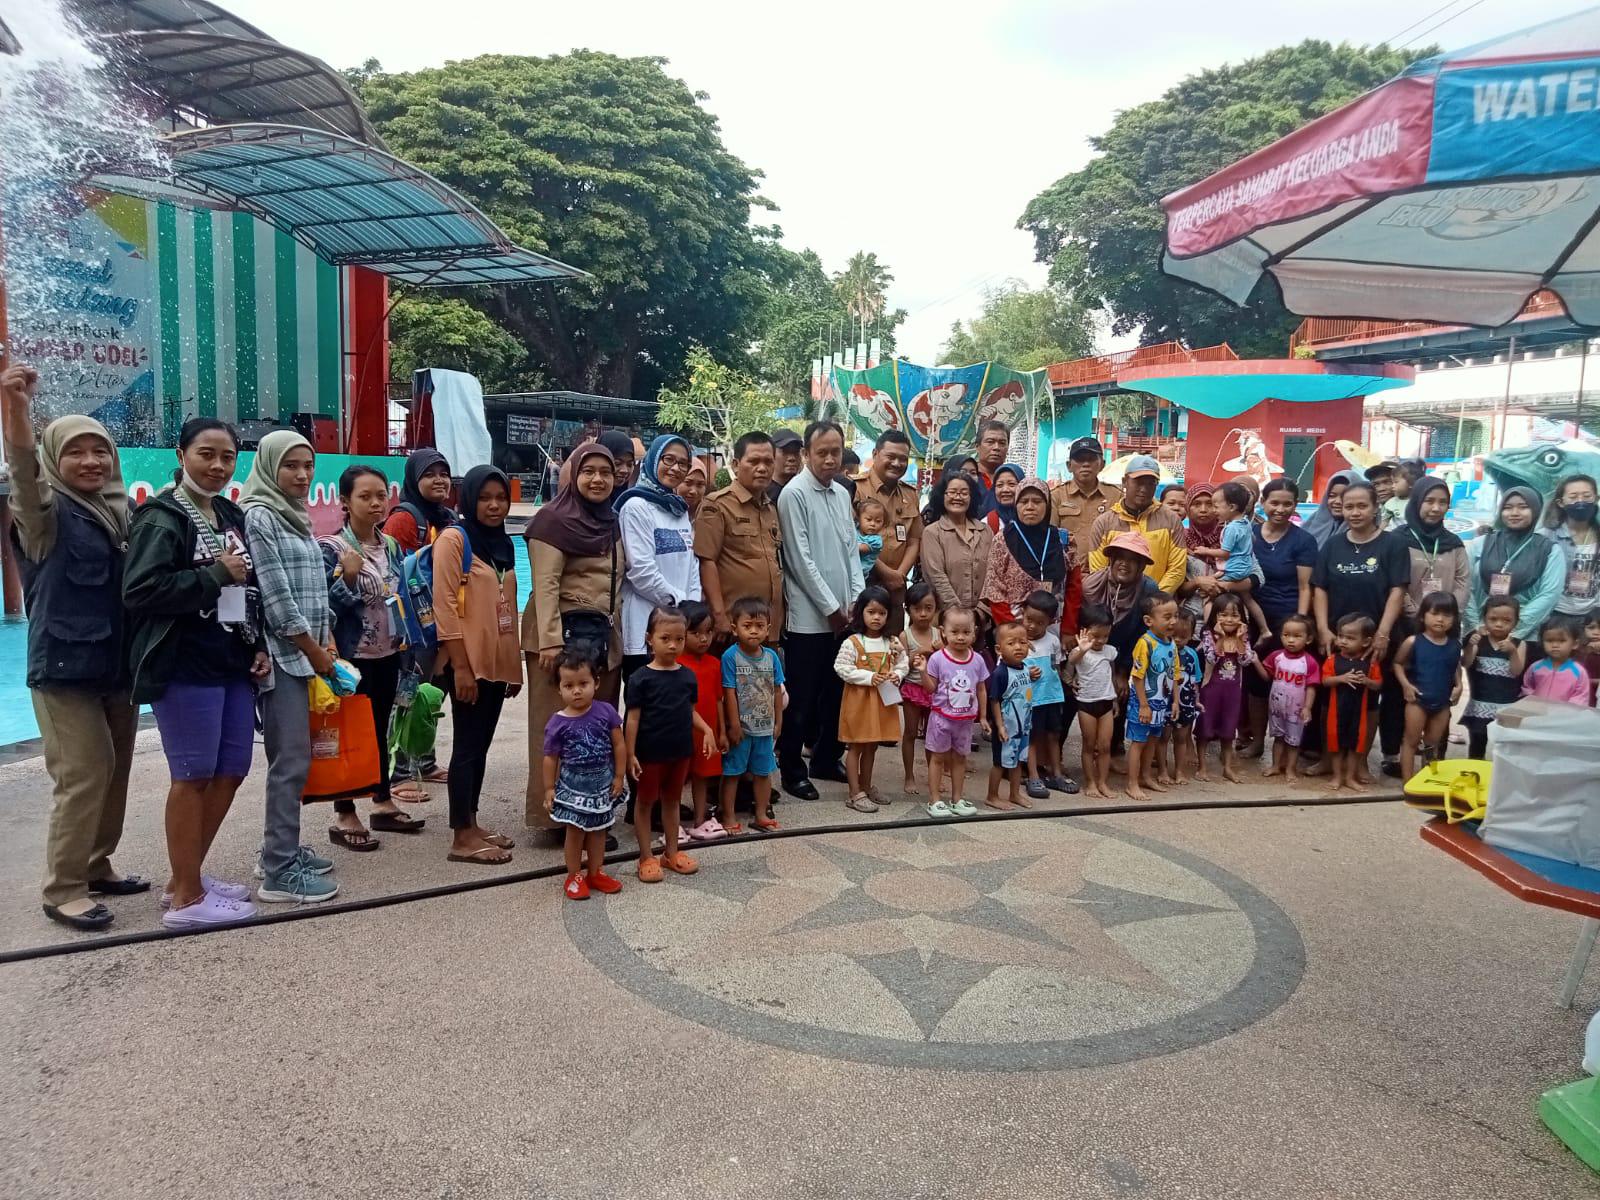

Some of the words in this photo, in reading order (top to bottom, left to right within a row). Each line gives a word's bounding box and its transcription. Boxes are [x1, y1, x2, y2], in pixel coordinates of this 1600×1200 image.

[1473, 69, 1600, 125] WATE
[1286, 135, 1357, 188] KELUARGA
[1356, 118, 1400, 163] ANDA
